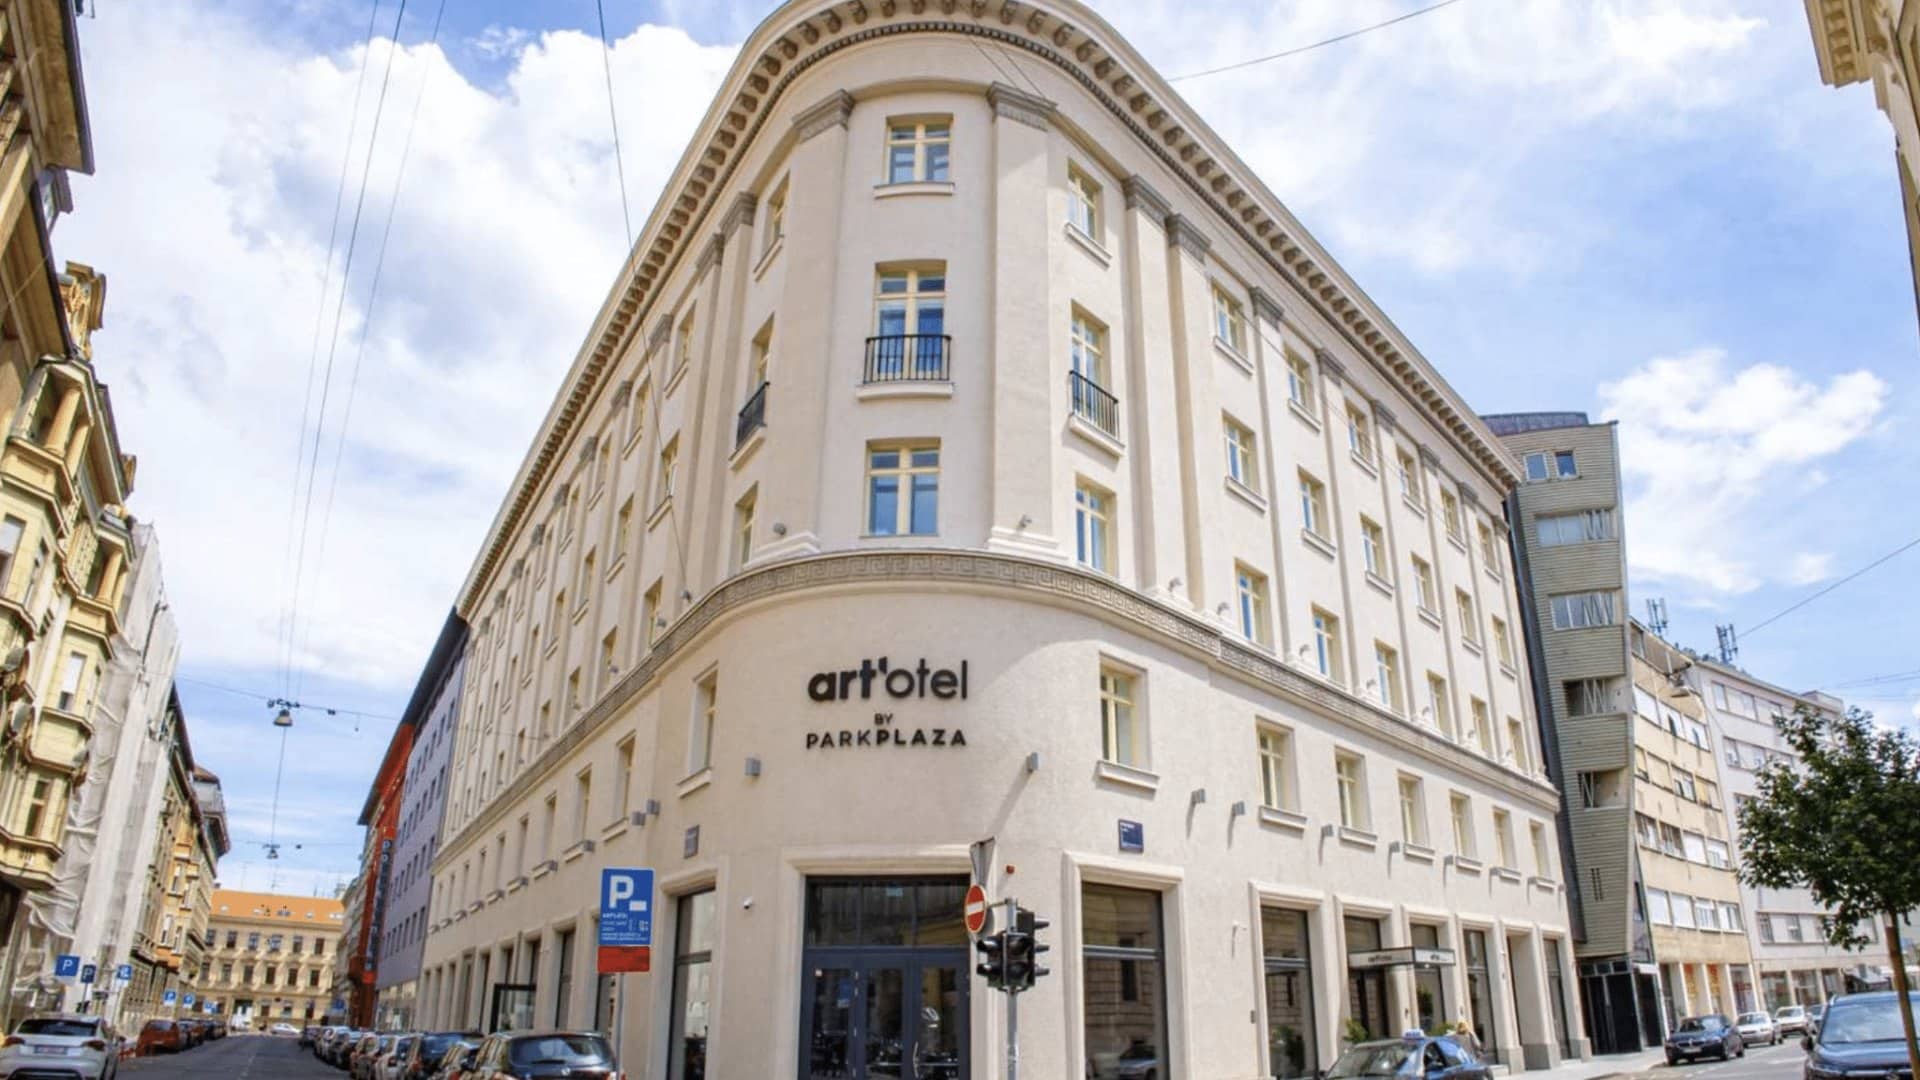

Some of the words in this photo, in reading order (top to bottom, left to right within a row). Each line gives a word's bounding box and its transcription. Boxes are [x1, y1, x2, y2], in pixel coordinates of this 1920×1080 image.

[807, 656, 968, 701] art'otel
[874, 713, 893, 725] BY
[609, 875, 634, 909] P
[62, 959, 73, 971] P
